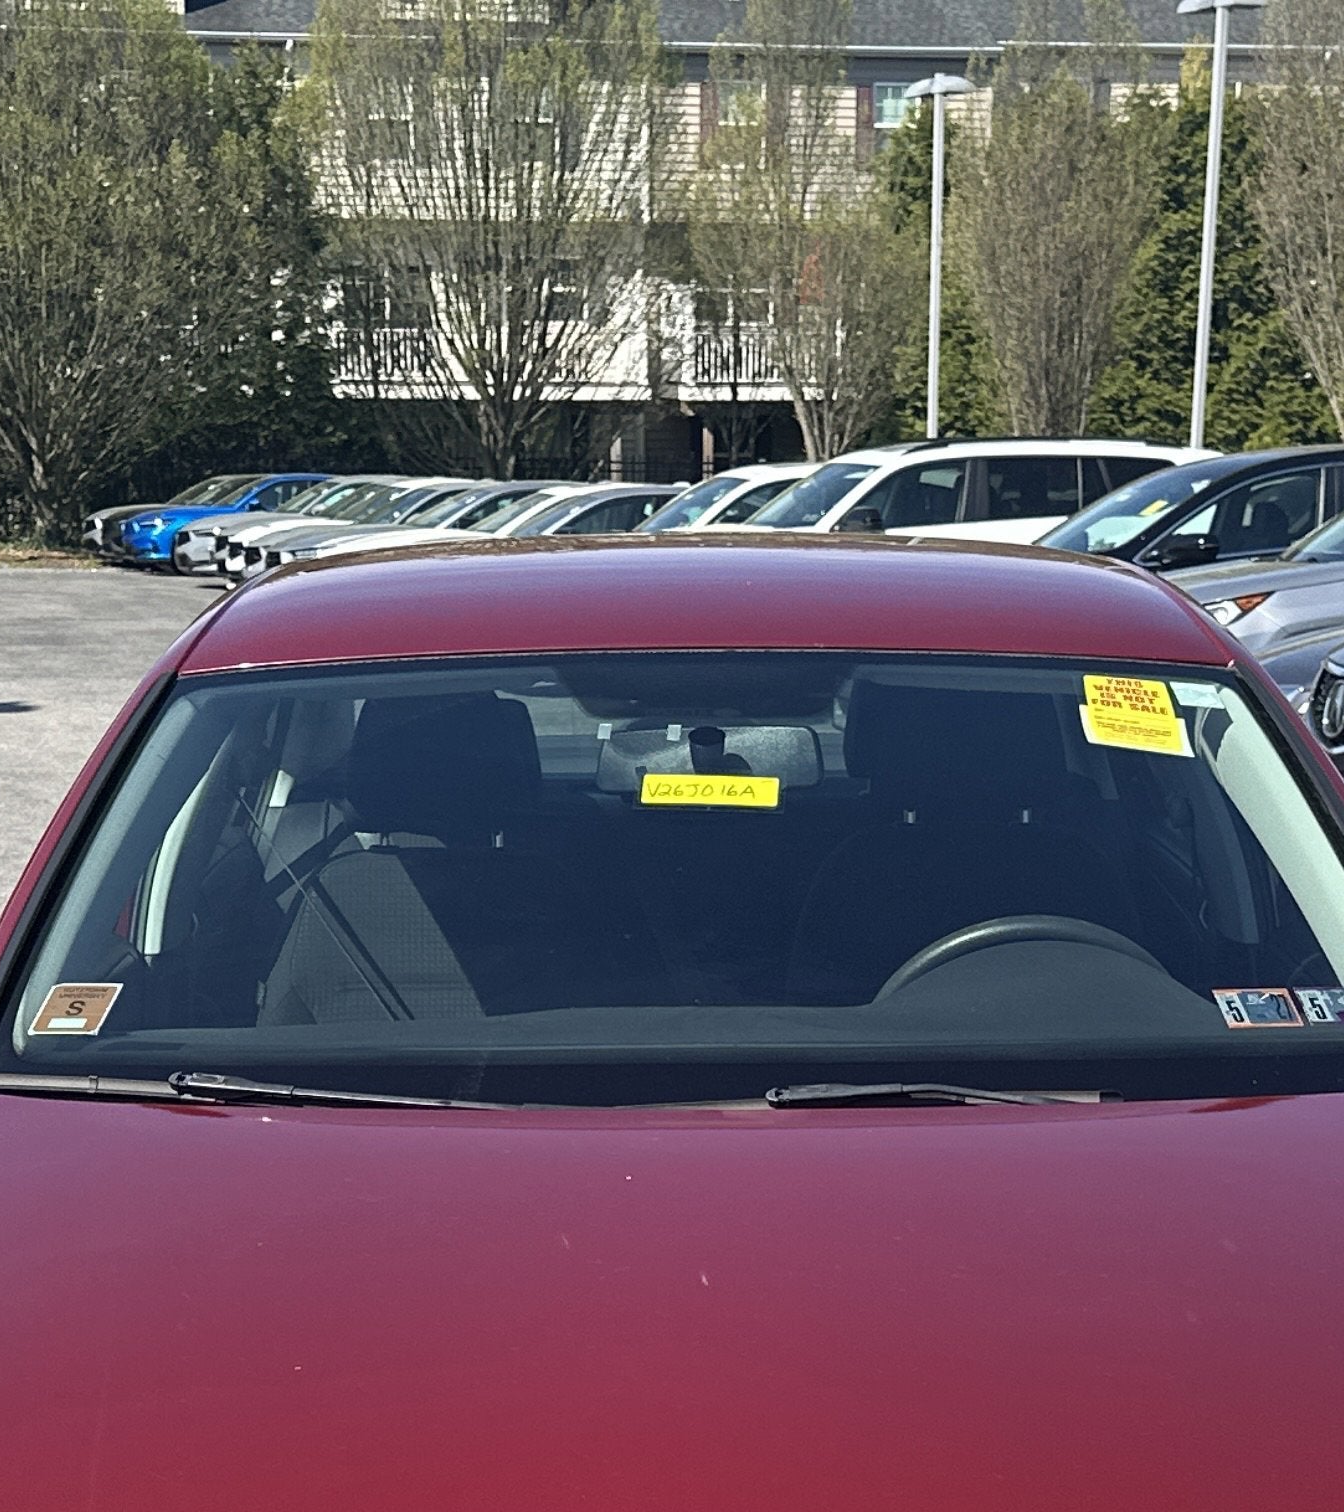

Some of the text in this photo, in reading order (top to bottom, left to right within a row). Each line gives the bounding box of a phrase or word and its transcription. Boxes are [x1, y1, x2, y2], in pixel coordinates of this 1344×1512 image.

[1092, 684, 1160, 698] VEHICLE
[1106, 678, 1143, 689] THIS
[1090, 698, 1169, 715] FOR SALE
[1099, 692, 1156, 705] IS NOT
[65, 1000, 86, 1016] S
[1225, 1000, 1245, 1023] 5
[1309, 997, 1328, 1020] 5
